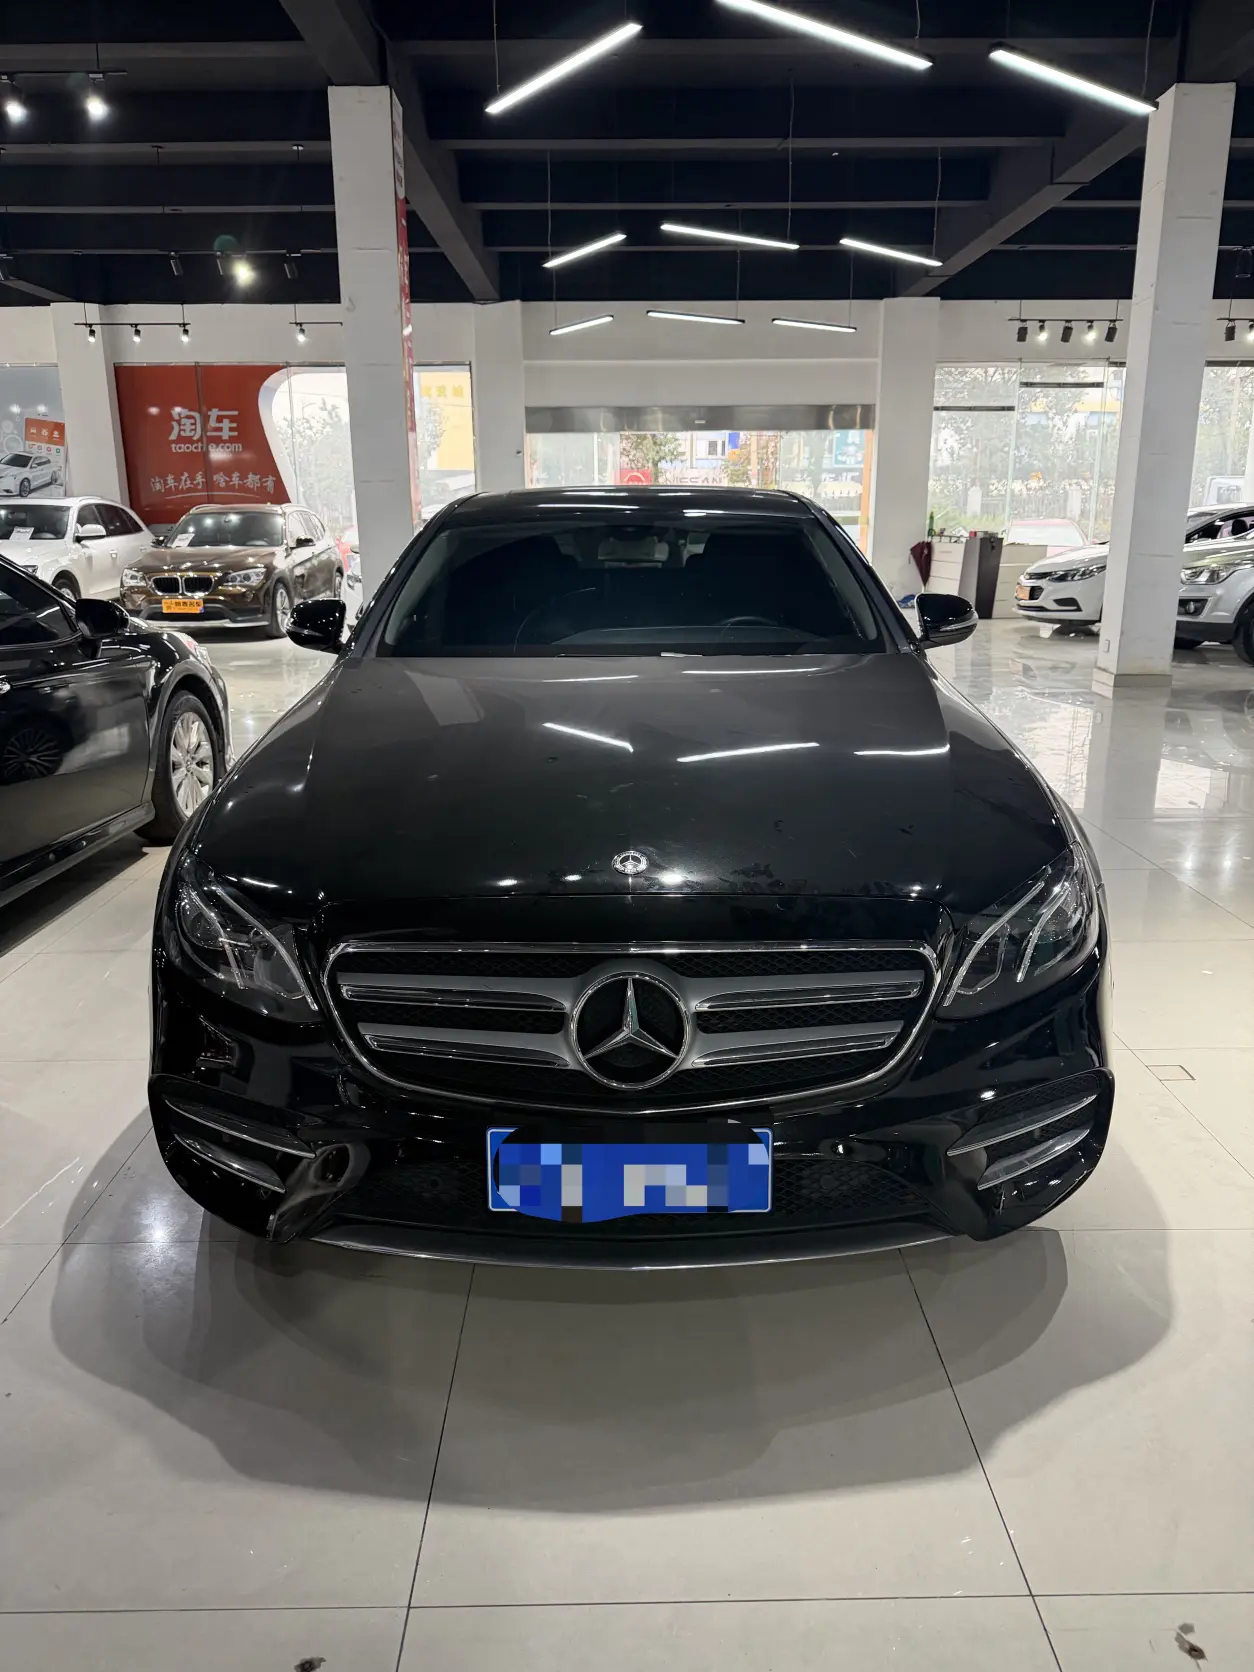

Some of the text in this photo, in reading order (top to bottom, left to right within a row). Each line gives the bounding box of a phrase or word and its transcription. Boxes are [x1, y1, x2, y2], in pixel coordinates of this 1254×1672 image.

[168, 408, 239, 441] 淘车
[170, 442, 243, 453] taoche.com
[150, 471, 277, 495] 淘车在手 啥车都有
